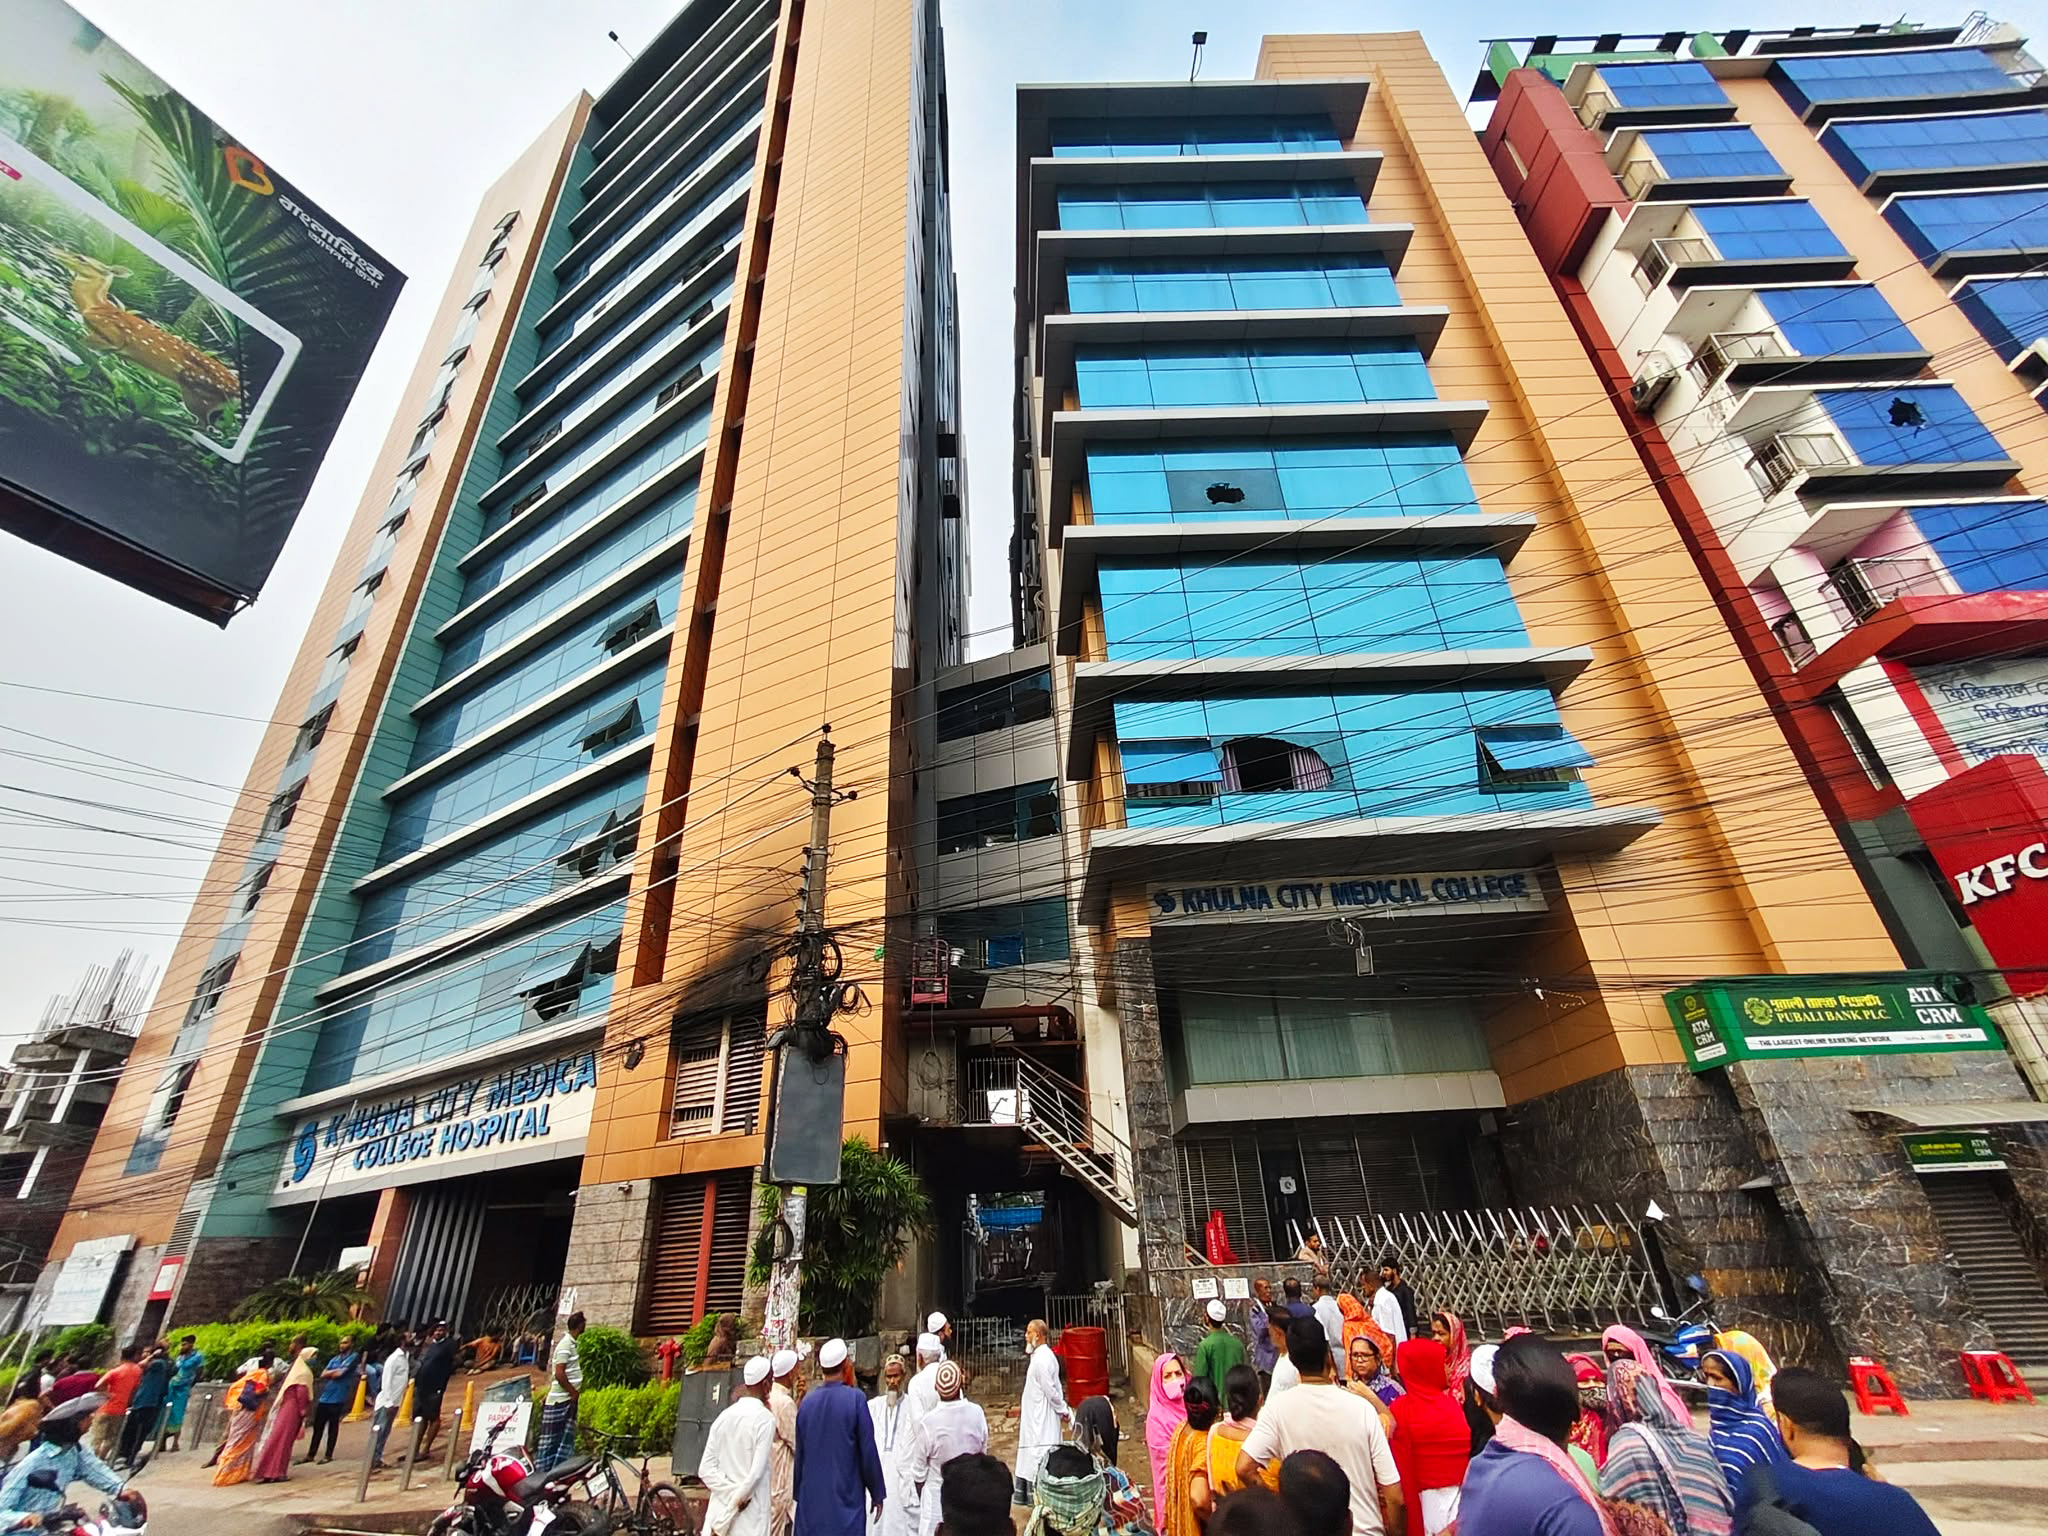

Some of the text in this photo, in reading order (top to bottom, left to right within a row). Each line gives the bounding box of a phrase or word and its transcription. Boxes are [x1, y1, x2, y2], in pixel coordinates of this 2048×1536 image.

[279, 194, 384, 281] বাংলালিংক
[308, 230, 354, 269] আপনার
[1954, 842, 2048, 905] KFC
[1183, 873, 1530, 914] KHULNA CITY MEDICAL COLLEGE
[1691, 1018, 1710, 1035] ATM
[1776, 1009, 1892, 1023] PUBALI BANK PLC.
[1915, 1007, 1963, 1024] CRM
[1695, 1031, 1715, 1046] CRM
[324, 1096, 416, 1148] KHULNA
[422, 1078, 483, 1124] CITY
[352, 1104, 550, 1171] COLLEGE HOSPITAL
[499, 1404, 511, 1414] NO
